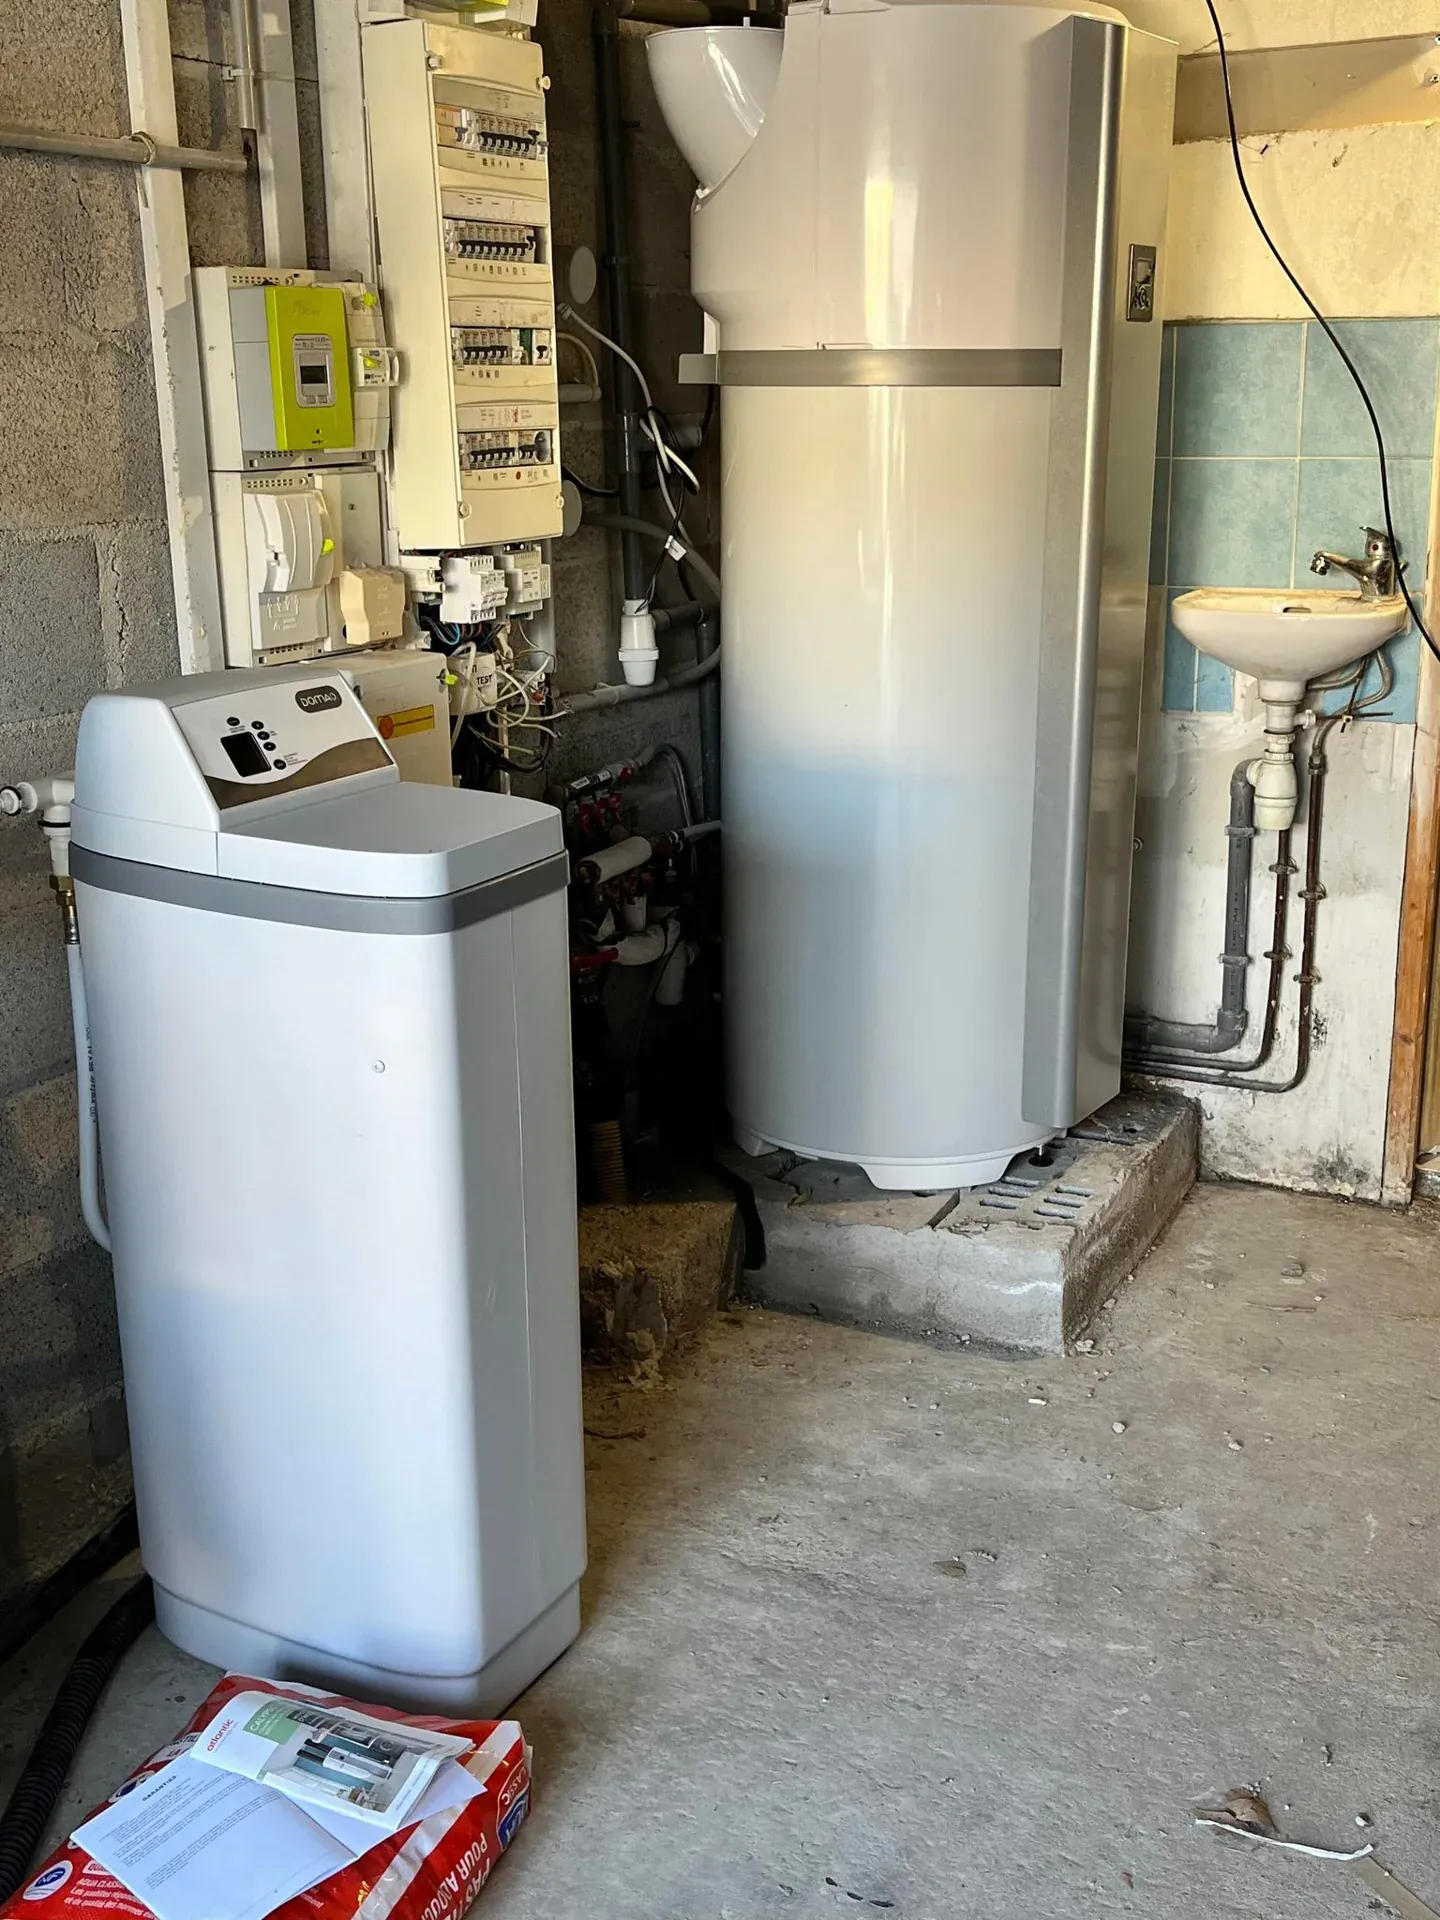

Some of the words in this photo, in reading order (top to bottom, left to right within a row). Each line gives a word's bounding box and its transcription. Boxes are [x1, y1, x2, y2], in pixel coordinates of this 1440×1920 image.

[476, 674, 492, 685] TEST
[207, 1718, 234, 1752] atlantic
[142, 1775, 177, 1801] GARANTIES
[455, 1832, 488, 1880] POUR
[37, 1871, 64, 1884] NF
